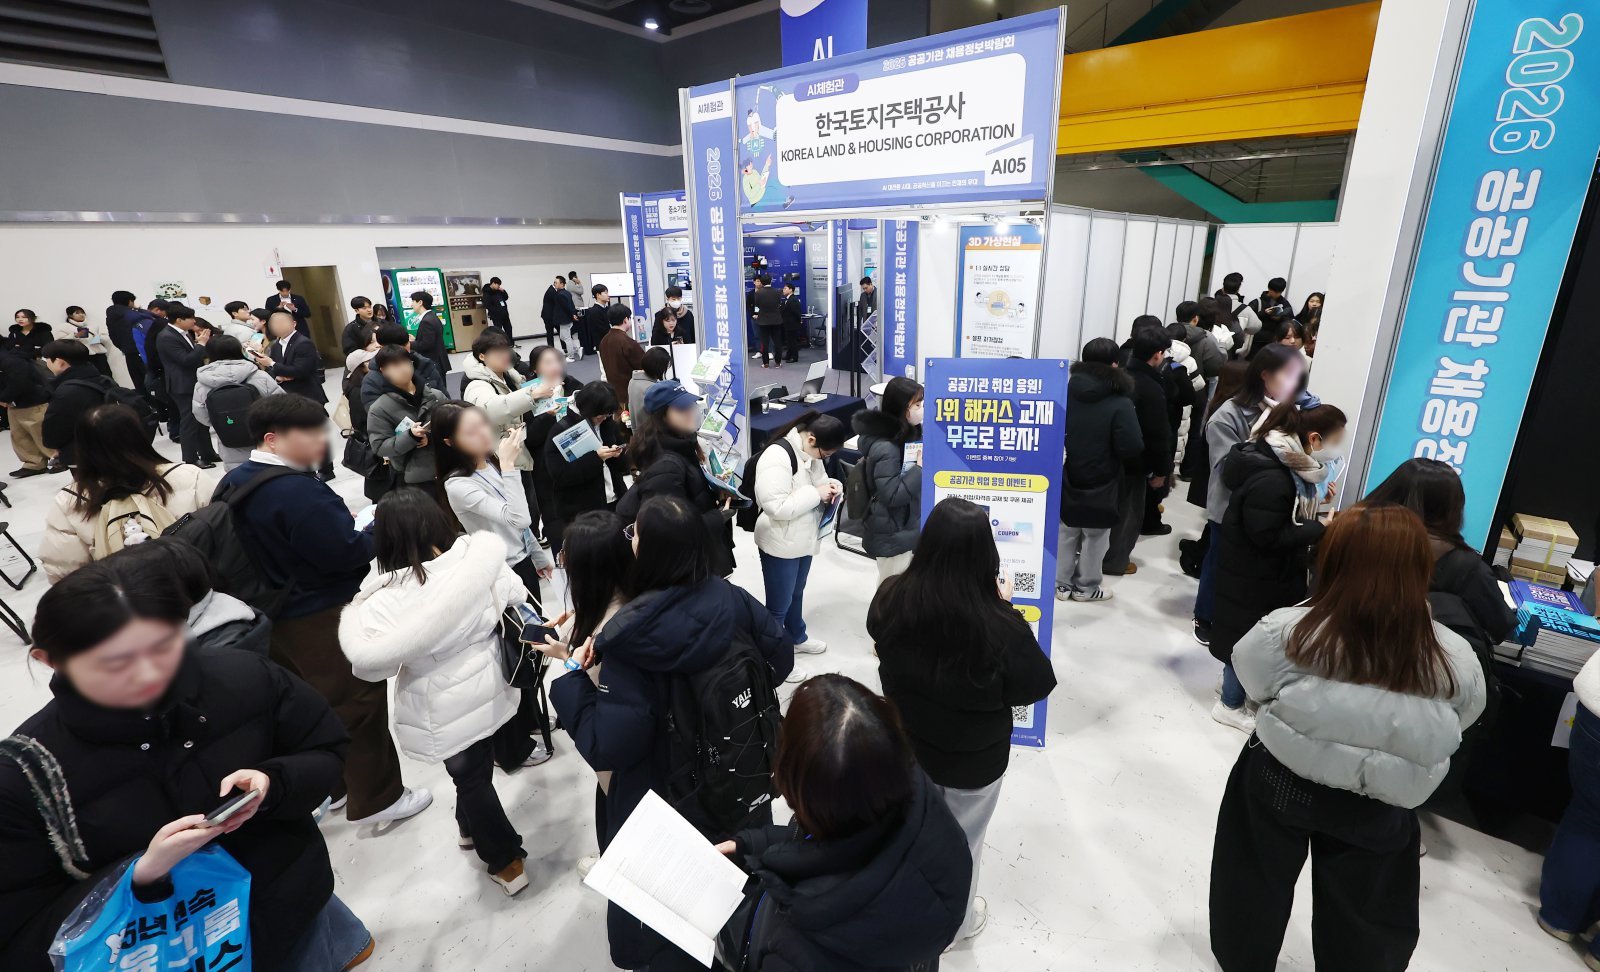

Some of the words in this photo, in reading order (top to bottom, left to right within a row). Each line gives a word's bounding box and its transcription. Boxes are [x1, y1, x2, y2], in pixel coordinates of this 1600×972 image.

[812, 35, 833, 61] AI
[908, 48, 944, 67] 공공기관
[946, 35, 1015, 60] 채용정보박람회
[807, 78, 845, 96] AI체험관
[1490, 12, 1584, 154] 2026
[698, 100, 724, 115] AI체험관
[815, 91, 966, 138] 한국토지주택공사
[781, 147, 814, 162] KOREA
[817, 143, 845, 158] LAND
[848, 142, 856, 155] &
[858, 135, 913, 154] HOUSING
[915, 123, 1015, 148] CORPORATION
[706, 147, 723, 201] 2026
[991, 157, 1026, 175] AI05
[709, 206, 729, 280] 공공기관
[968, 237, 982, 247] 3D
[983, 236, 1021, 247] 가상현실
[1443, 168, 1542, 348] 공공기관
[894, 272, 906, 359] 채용정보박람회
[948, 377, 989, 393] 공공기관
[991, 378, 1013, 394] 취업
[1016, 379, 1043, 394] 응원!
[935, 398, 960, 423] 1위
[964, 398, 1014, 424] 해커스
[1018, 400, 1055, 425] 교재
[947, 425, 995, 450] 무료로
[999, 426, 1040, 452] 받자!
[949, 475, 975, 486] 공공기관
[977, 476, 990, 486] 취업
[991, 477, 1005, 487] 응원
[1006, 477, 1027, 488] 이벤트
[731, 687, 752, 708] YALE
